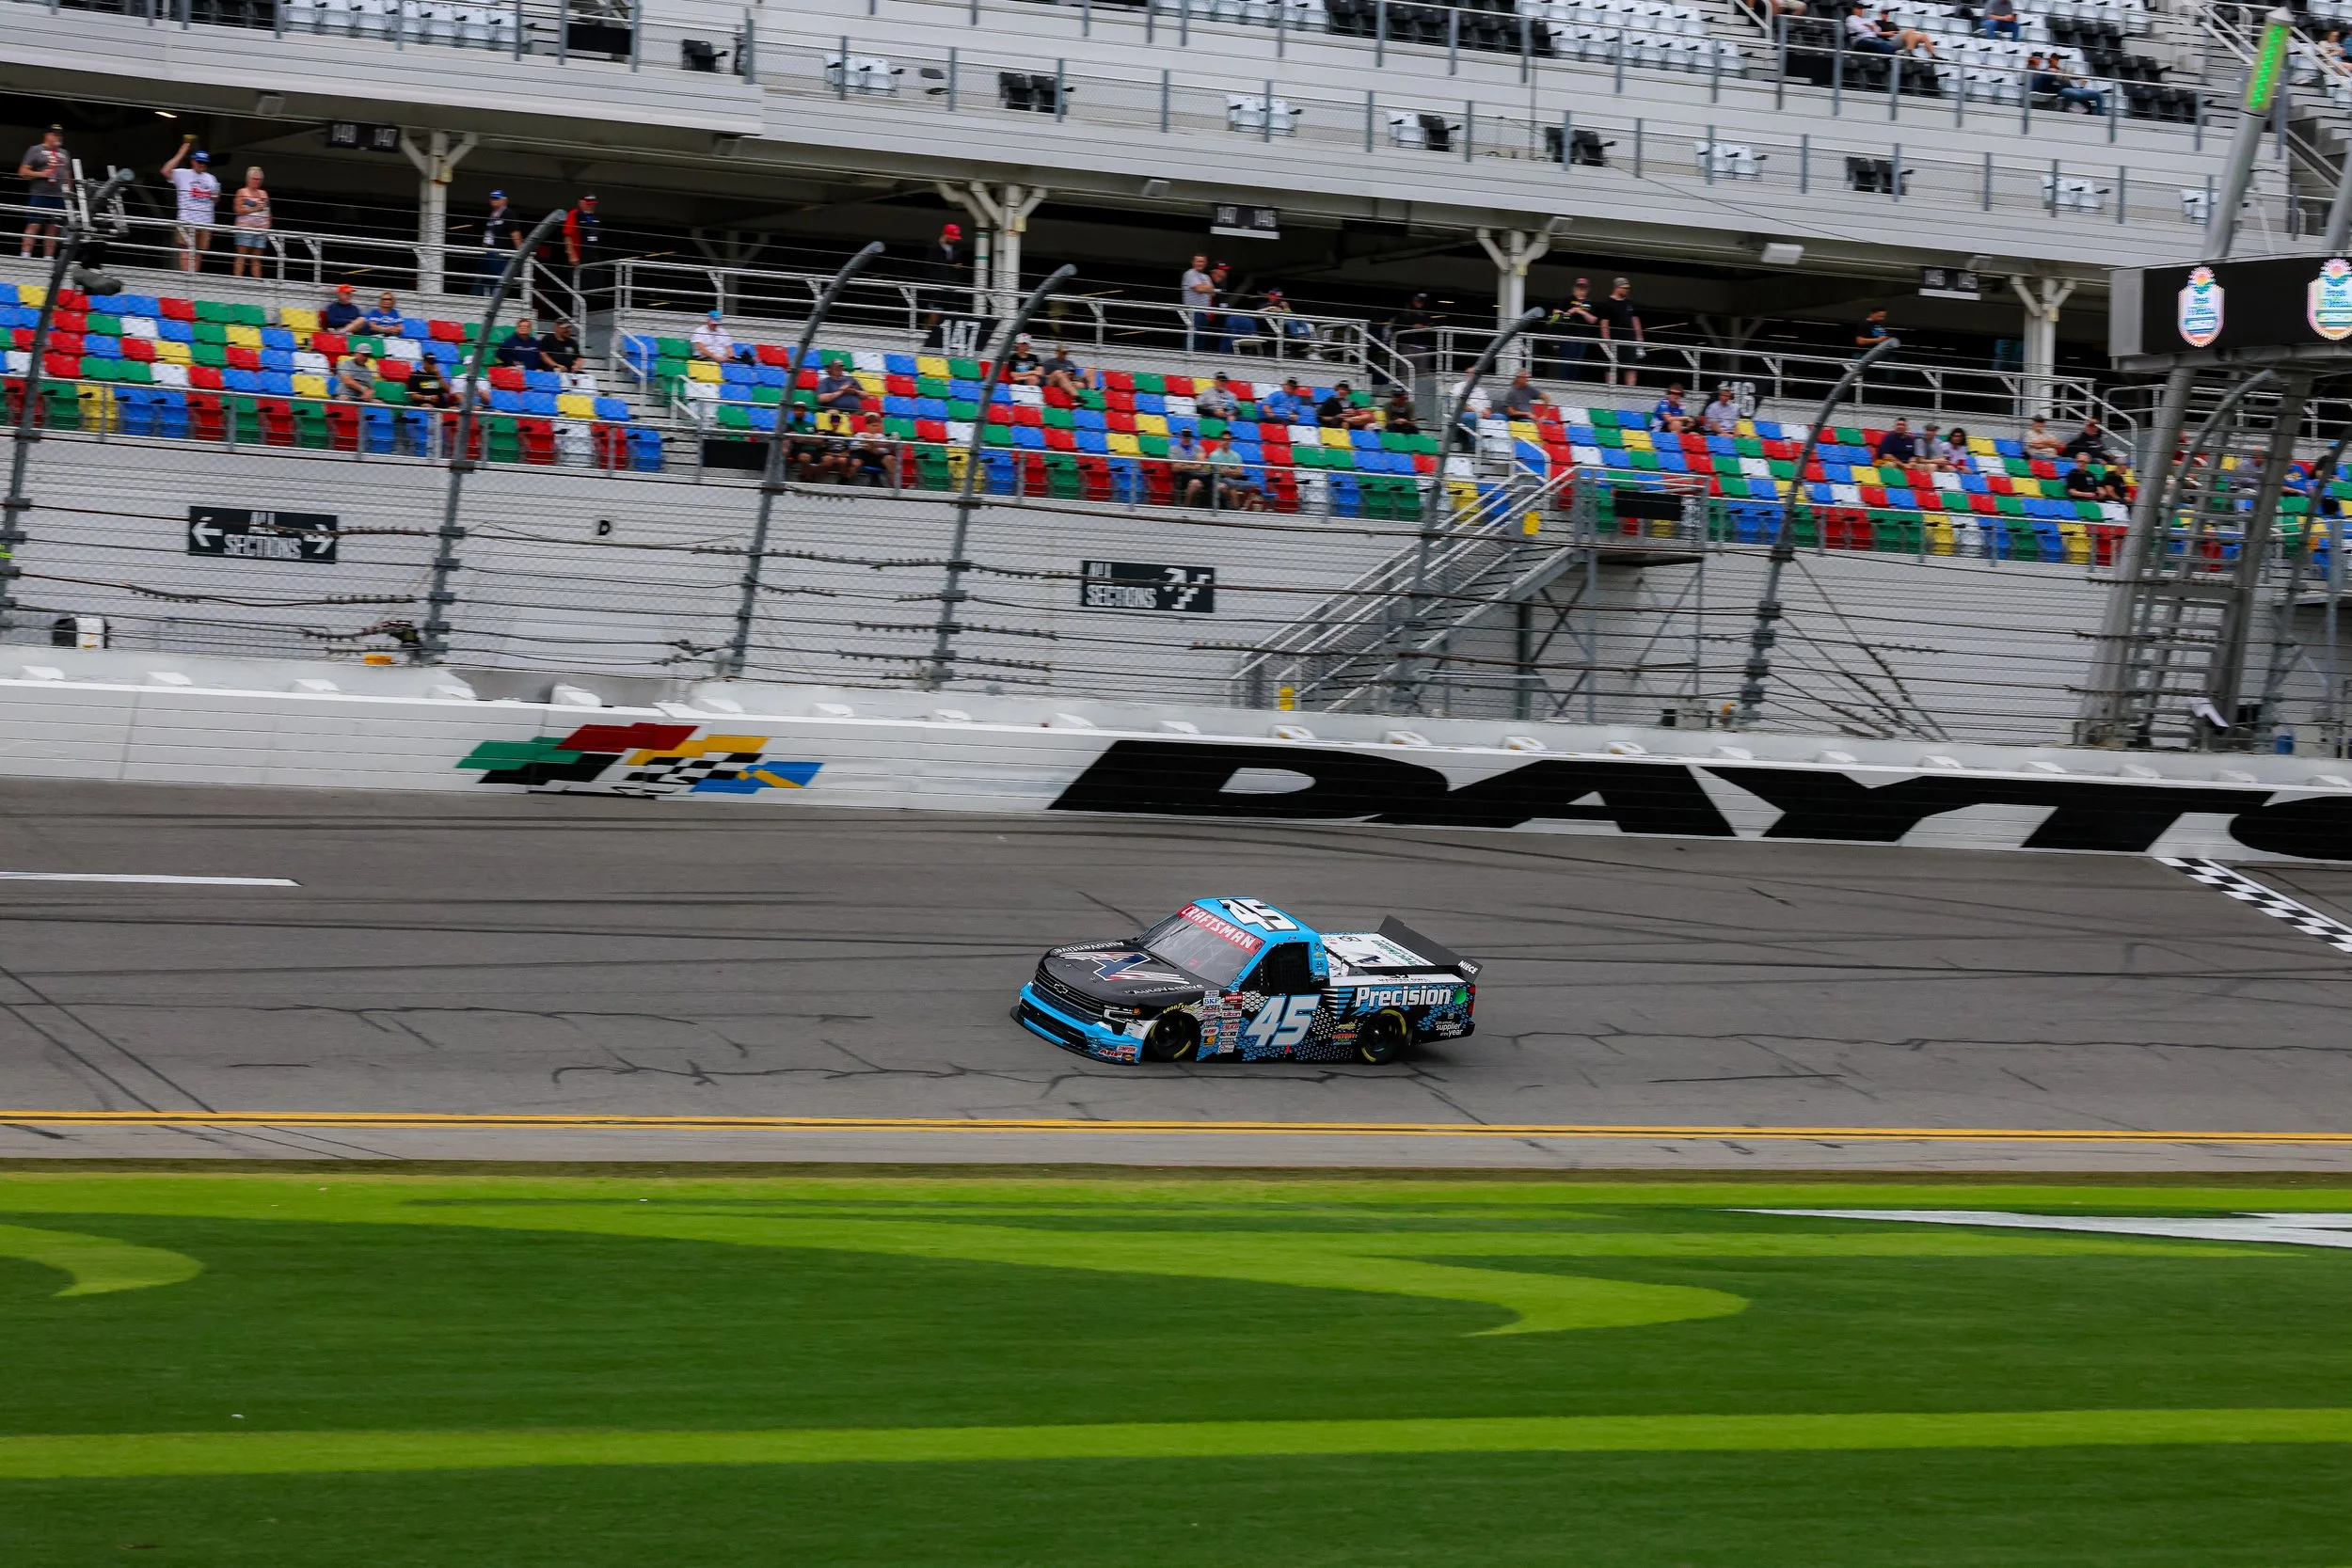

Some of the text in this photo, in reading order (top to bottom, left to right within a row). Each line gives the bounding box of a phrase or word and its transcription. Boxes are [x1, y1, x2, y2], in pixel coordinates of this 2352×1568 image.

[374, 129, 397, 147] 147
[1217, 207, 1276, 227] 147 146
[1925, 270, 1945, 286] 146
[940, 320, 981, 356] 147
[248, 512, 278, 534] ALL
[598, 520, 611, 535] D
[223, 533, 302, 559] SECTIONS
[1087, 562, 1114, 584] ALL
[1086, 584, 1157, 609] SECTIONS
[1045, 739, 2352, 861] DAYT
[1217, 898, 1299, 932] 45
[1181, 906, 1255, 949] CRAFTSMAN
[1458, 959, 1478, 974] NIECE
[1134, 984, 1205, 996] AutoVentive
[1355, 985, 1451, 1007] Precision
[1243, 994, 1321, 1048] 45
[1436, 1022, 1461, 1032] supplier
[1449, 1029, 1463, 1037] year
[1099, 1048, 1122, 1058] ARP
